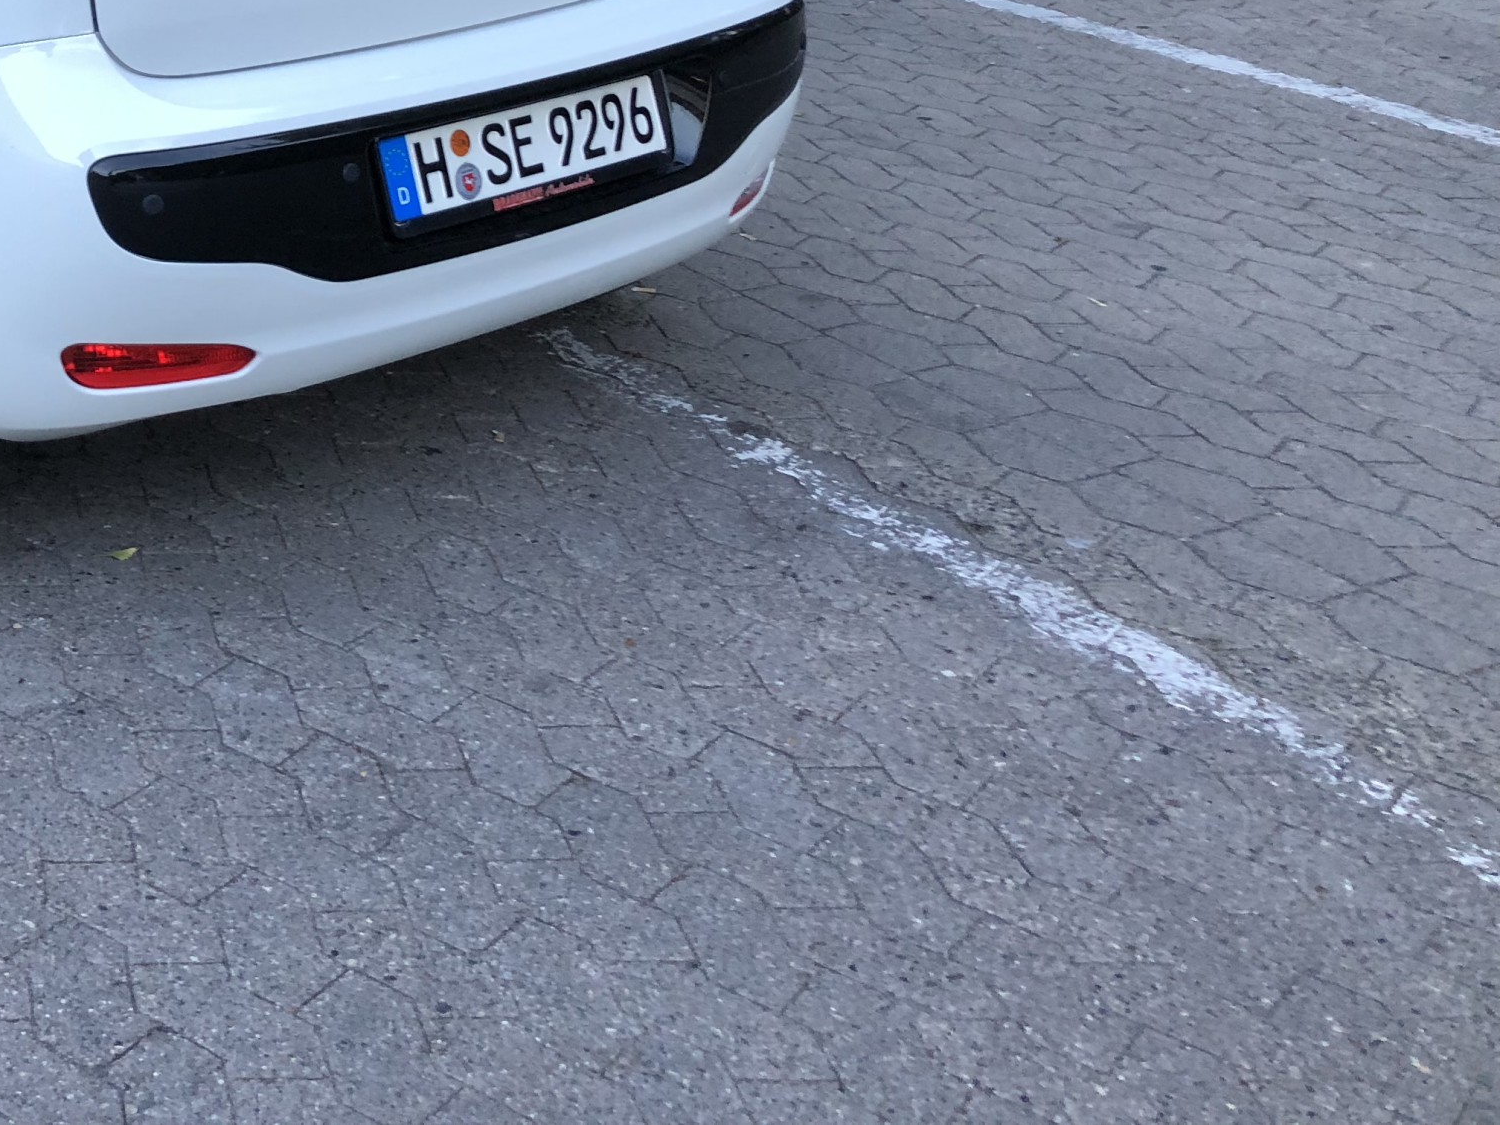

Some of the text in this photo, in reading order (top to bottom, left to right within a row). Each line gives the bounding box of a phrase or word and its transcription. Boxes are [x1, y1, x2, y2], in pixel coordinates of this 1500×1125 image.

[399, 86, 654, 205] D H SE 9296
